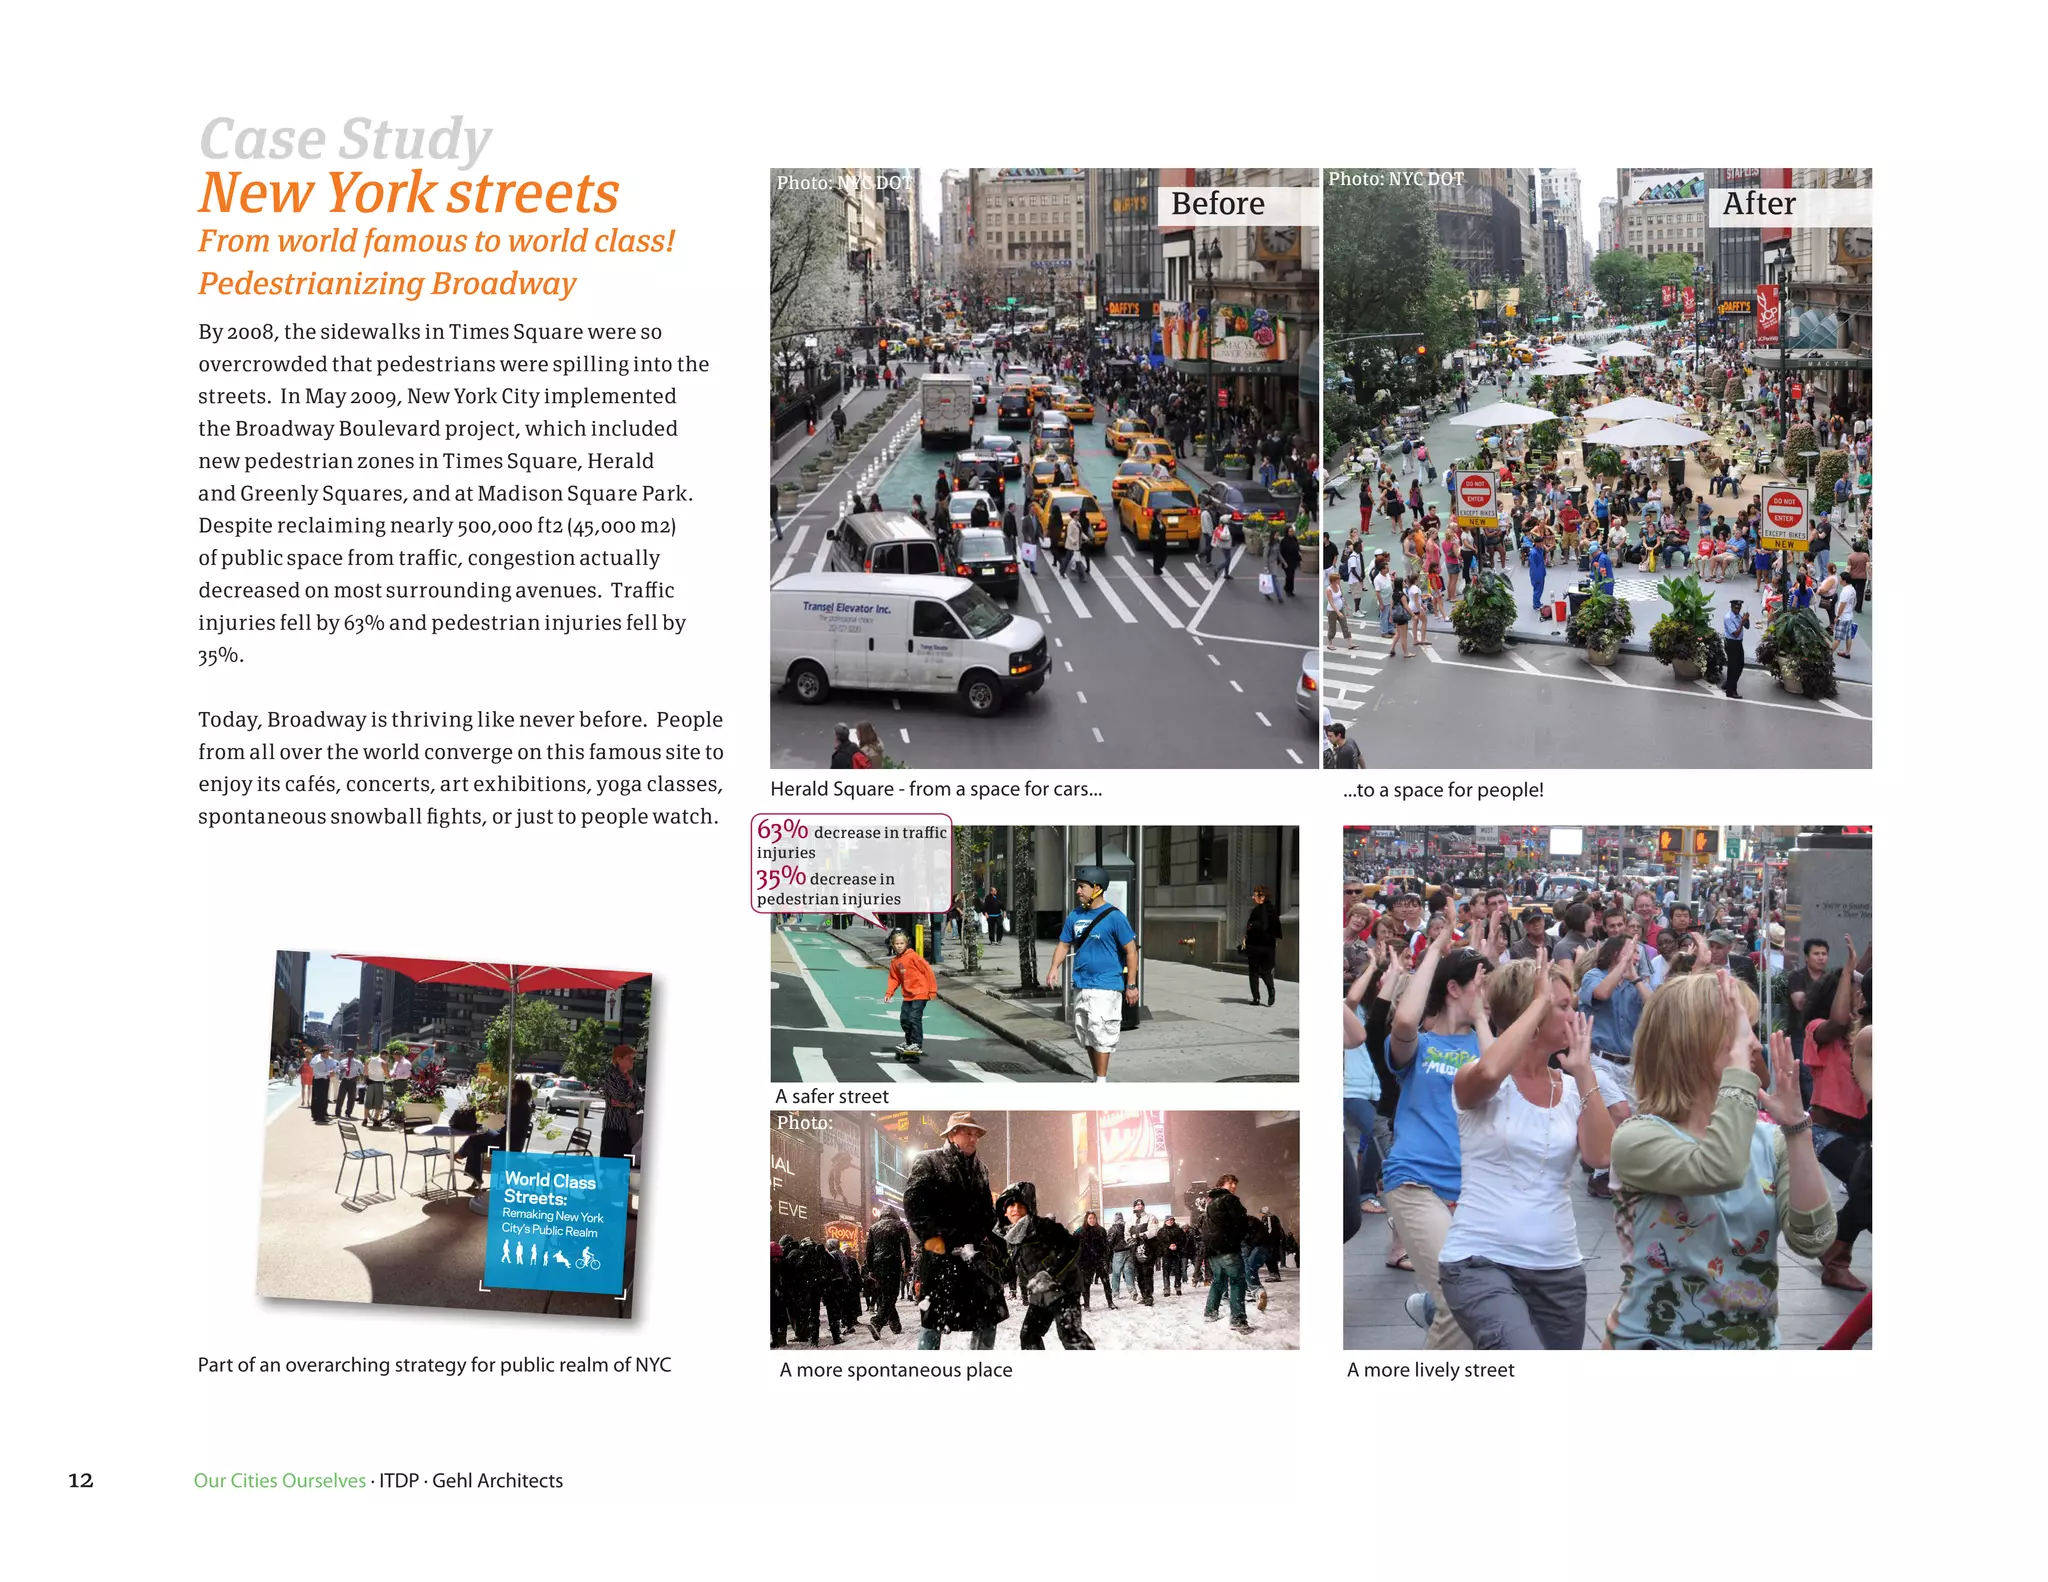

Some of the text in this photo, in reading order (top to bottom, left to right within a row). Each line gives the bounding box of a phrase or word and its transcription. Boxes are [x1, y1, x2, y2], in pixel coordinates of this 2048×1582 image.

[201, 115, 493, 171] Case Study
[197, 168, 619, 213] New York streets
[198, 227, 676, 258] From world famous to world class!
[197, 270, 578, 301] Pedestrianizing Broadway
[1109, 302, 1140, 314] DAFFY'S
[1724, 301, 1751, 311] DAFFY'S
[1759, 307, 1778, 323] JCP
[199, 516, 675, 537] Despite reclaiming nearly 500,000 ft2 (45,000 m2)
[1775, 540, 1794, 548] NEW
[803, 601, 891, 614] Transel Elevator Inc.
[199, 647, 243, 666] 35%.
[198, 710, 723, 731] Today, Broadway is thriving like never before. People
[772, 781, 828, 796] Herald
[834, 781, 894, 800] Square
[909, 780, 950, 796] from
[956, 785, 965, 796] a
[971, 785, 1020, 800] space
[1025, 780, 1049, 796] for
[1054, 785, 1102, 796] cars...
[1344, 781, 1543, 801] ...to a space for people!
[199, 807, 718, 828] spontaneous snowball fights, or just to people watch.
[775, 1088, 889, 1103] A safer street
[505, 1170, 597, 1190] World Class
[504, 1188, 568, 1206] Streets:
[502, 1207, 604, 1223] Remaking New York
[779, 1200, 807, 1219] EVE
[501, 1222, 598, 1238] City's Public Realm
[199, 1356, 671, 1376] Part of an overarching strategy for public realm of NYC
[780, 1362, 1012, 1381] A more spontaneous place
[1347, 1362, 1515, 1381] A more lively street
[69, 1473, 93, 1488] 12
[194, 1472, 563, 1488] Our Cities Ourselves ITDP Gehl Architects
